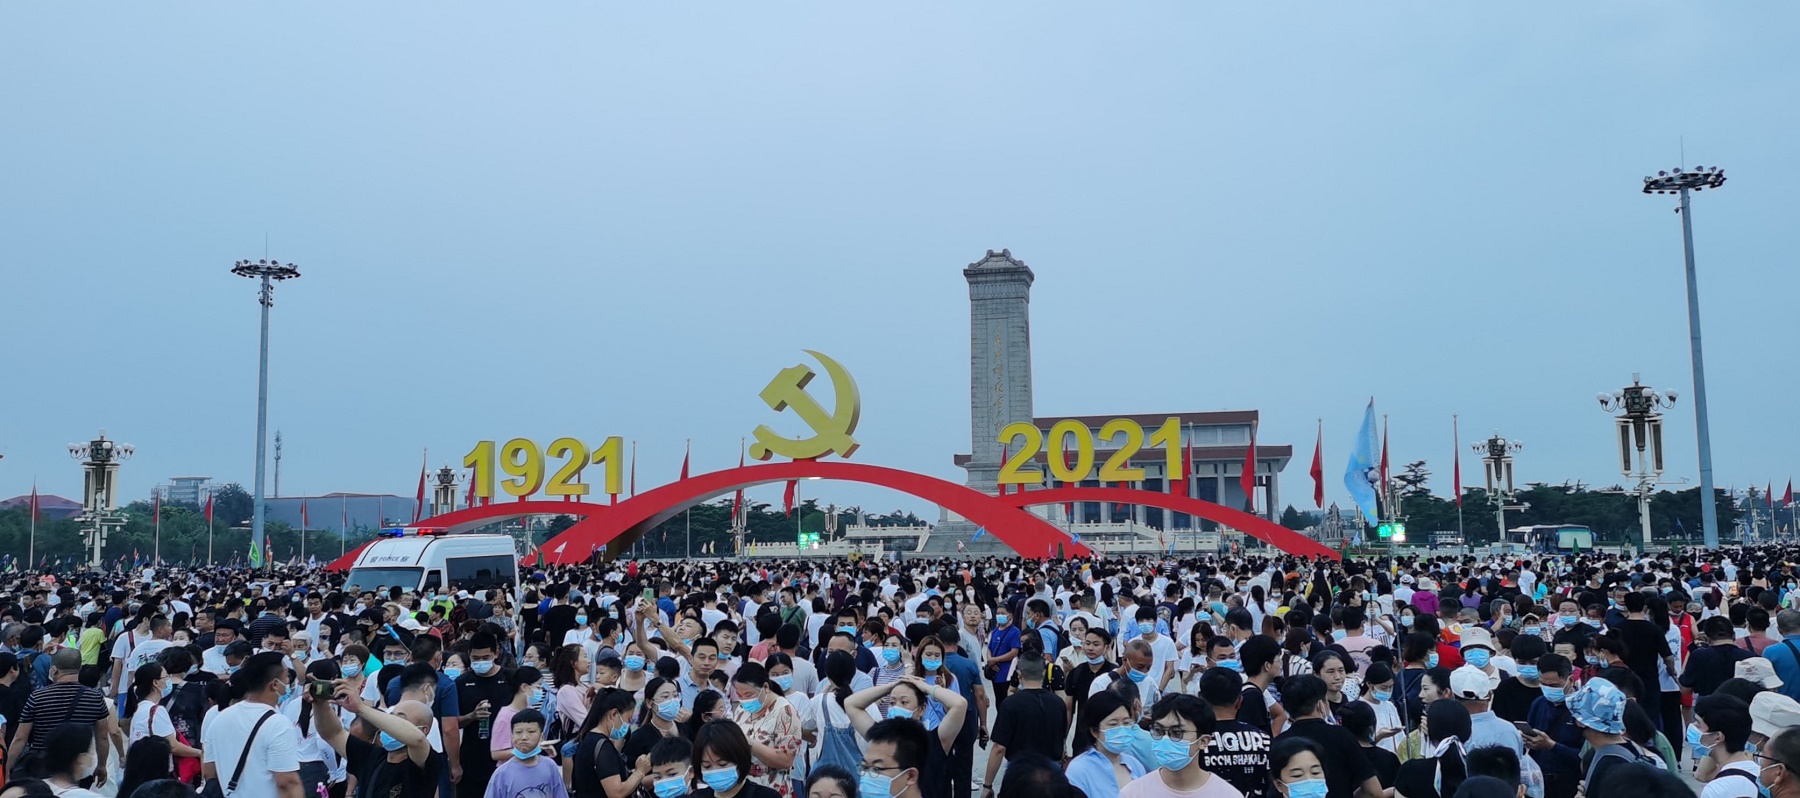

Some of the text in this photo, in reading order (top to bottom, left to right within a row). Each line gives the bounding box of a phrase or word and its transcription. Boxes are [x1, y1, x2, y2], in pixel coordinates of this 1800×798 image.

[463, 436, 623, 498] 1921
[997, 417, 1182, 484] 2021
[1203, 731, 1271, 753] FIGURE
[1204, 755, 1232, 766] BOOM
